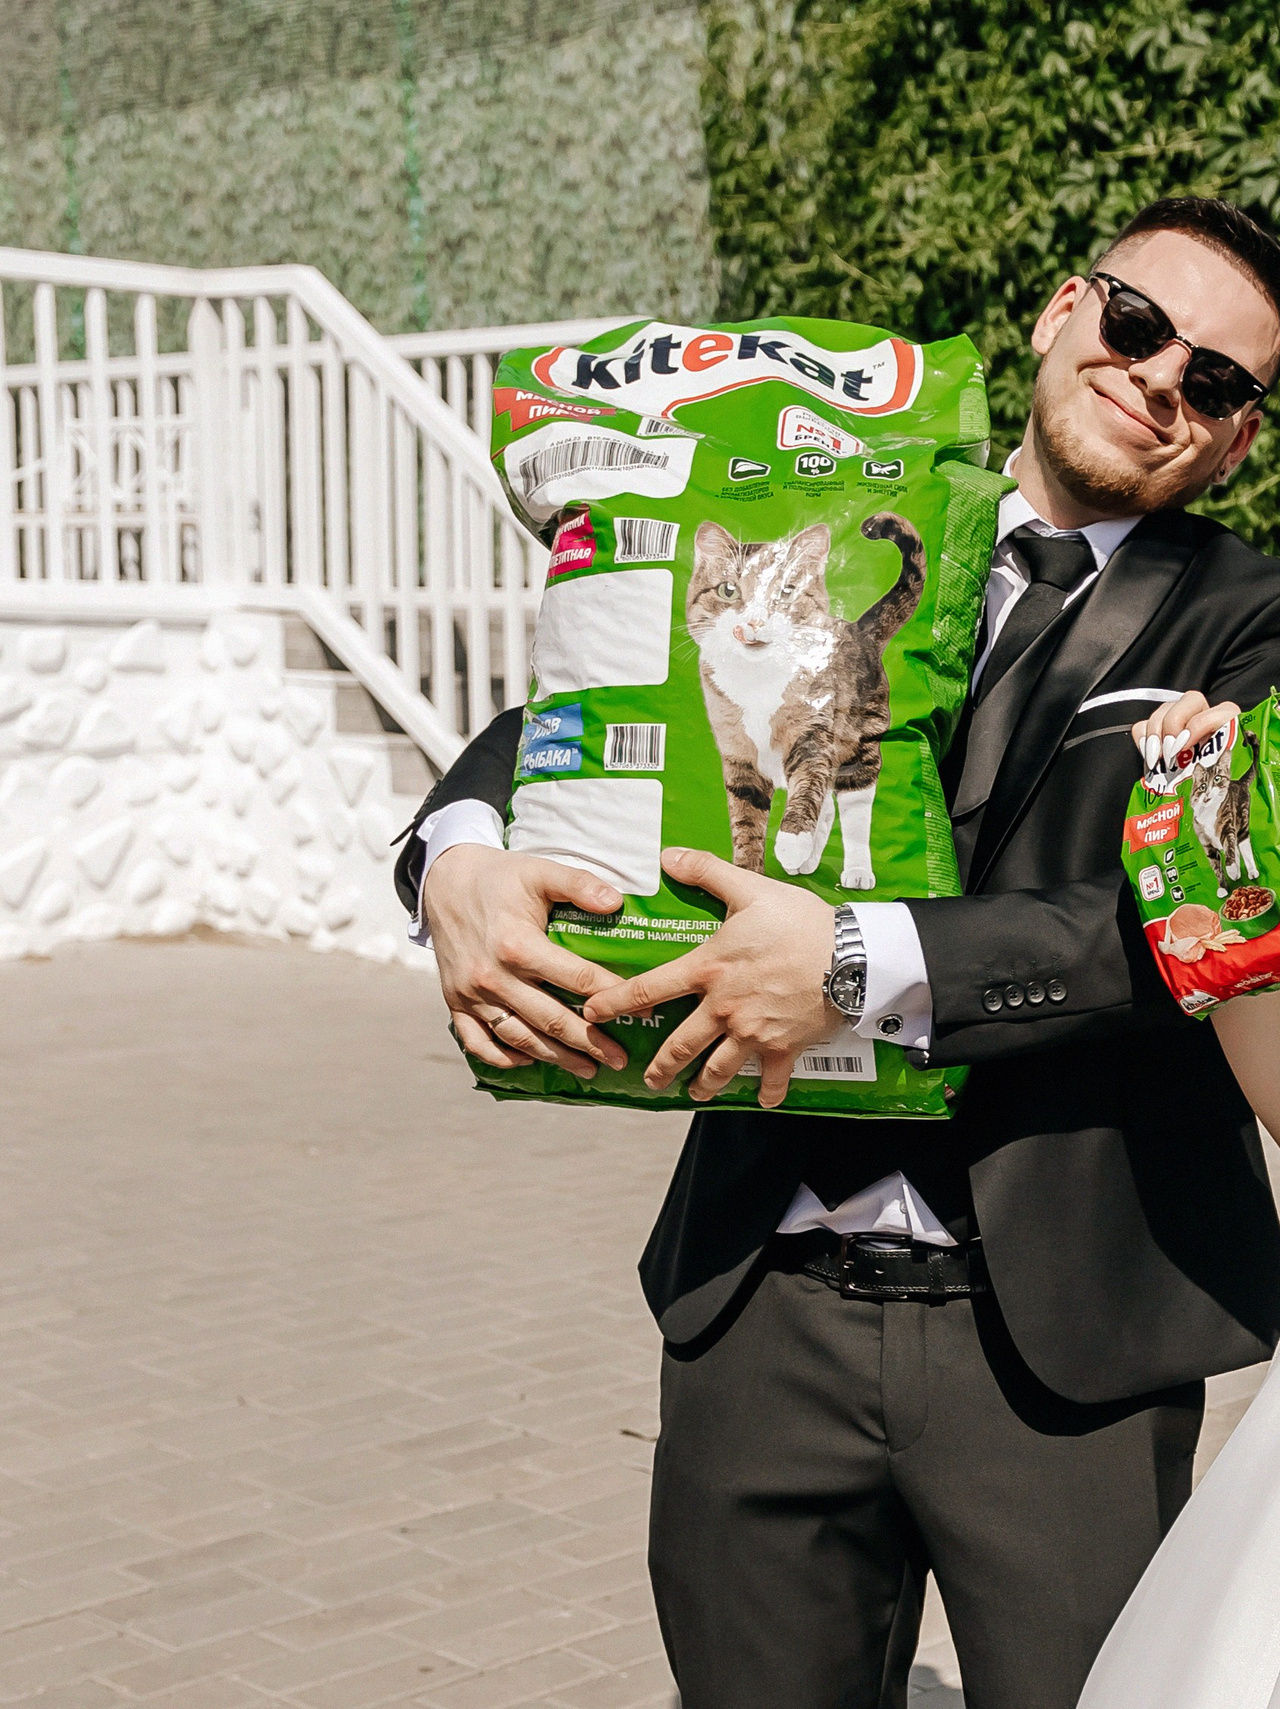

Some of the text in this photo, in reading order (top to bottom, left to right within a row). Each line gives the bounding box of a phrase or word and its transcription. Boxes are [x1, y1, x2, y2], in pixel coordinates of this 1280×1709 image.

[572, 334, 873, 402] kitekat
[800, 456, 832, 469] 100
[550, 548, 591, 568] ПЕТИТНАЯ
[524, 749, 571, 770] РЫБАКА
[1136, 802, 1180, 830] МЯСНОЙ
[1144, 828, 1168, 843] ПИР
[553, 909, 724, 931] ПАКОВАННОГО КОРМА ОПРЕДЕЛЯЕТС
[647, 931, 714, 944] НАИМЕНОВА
